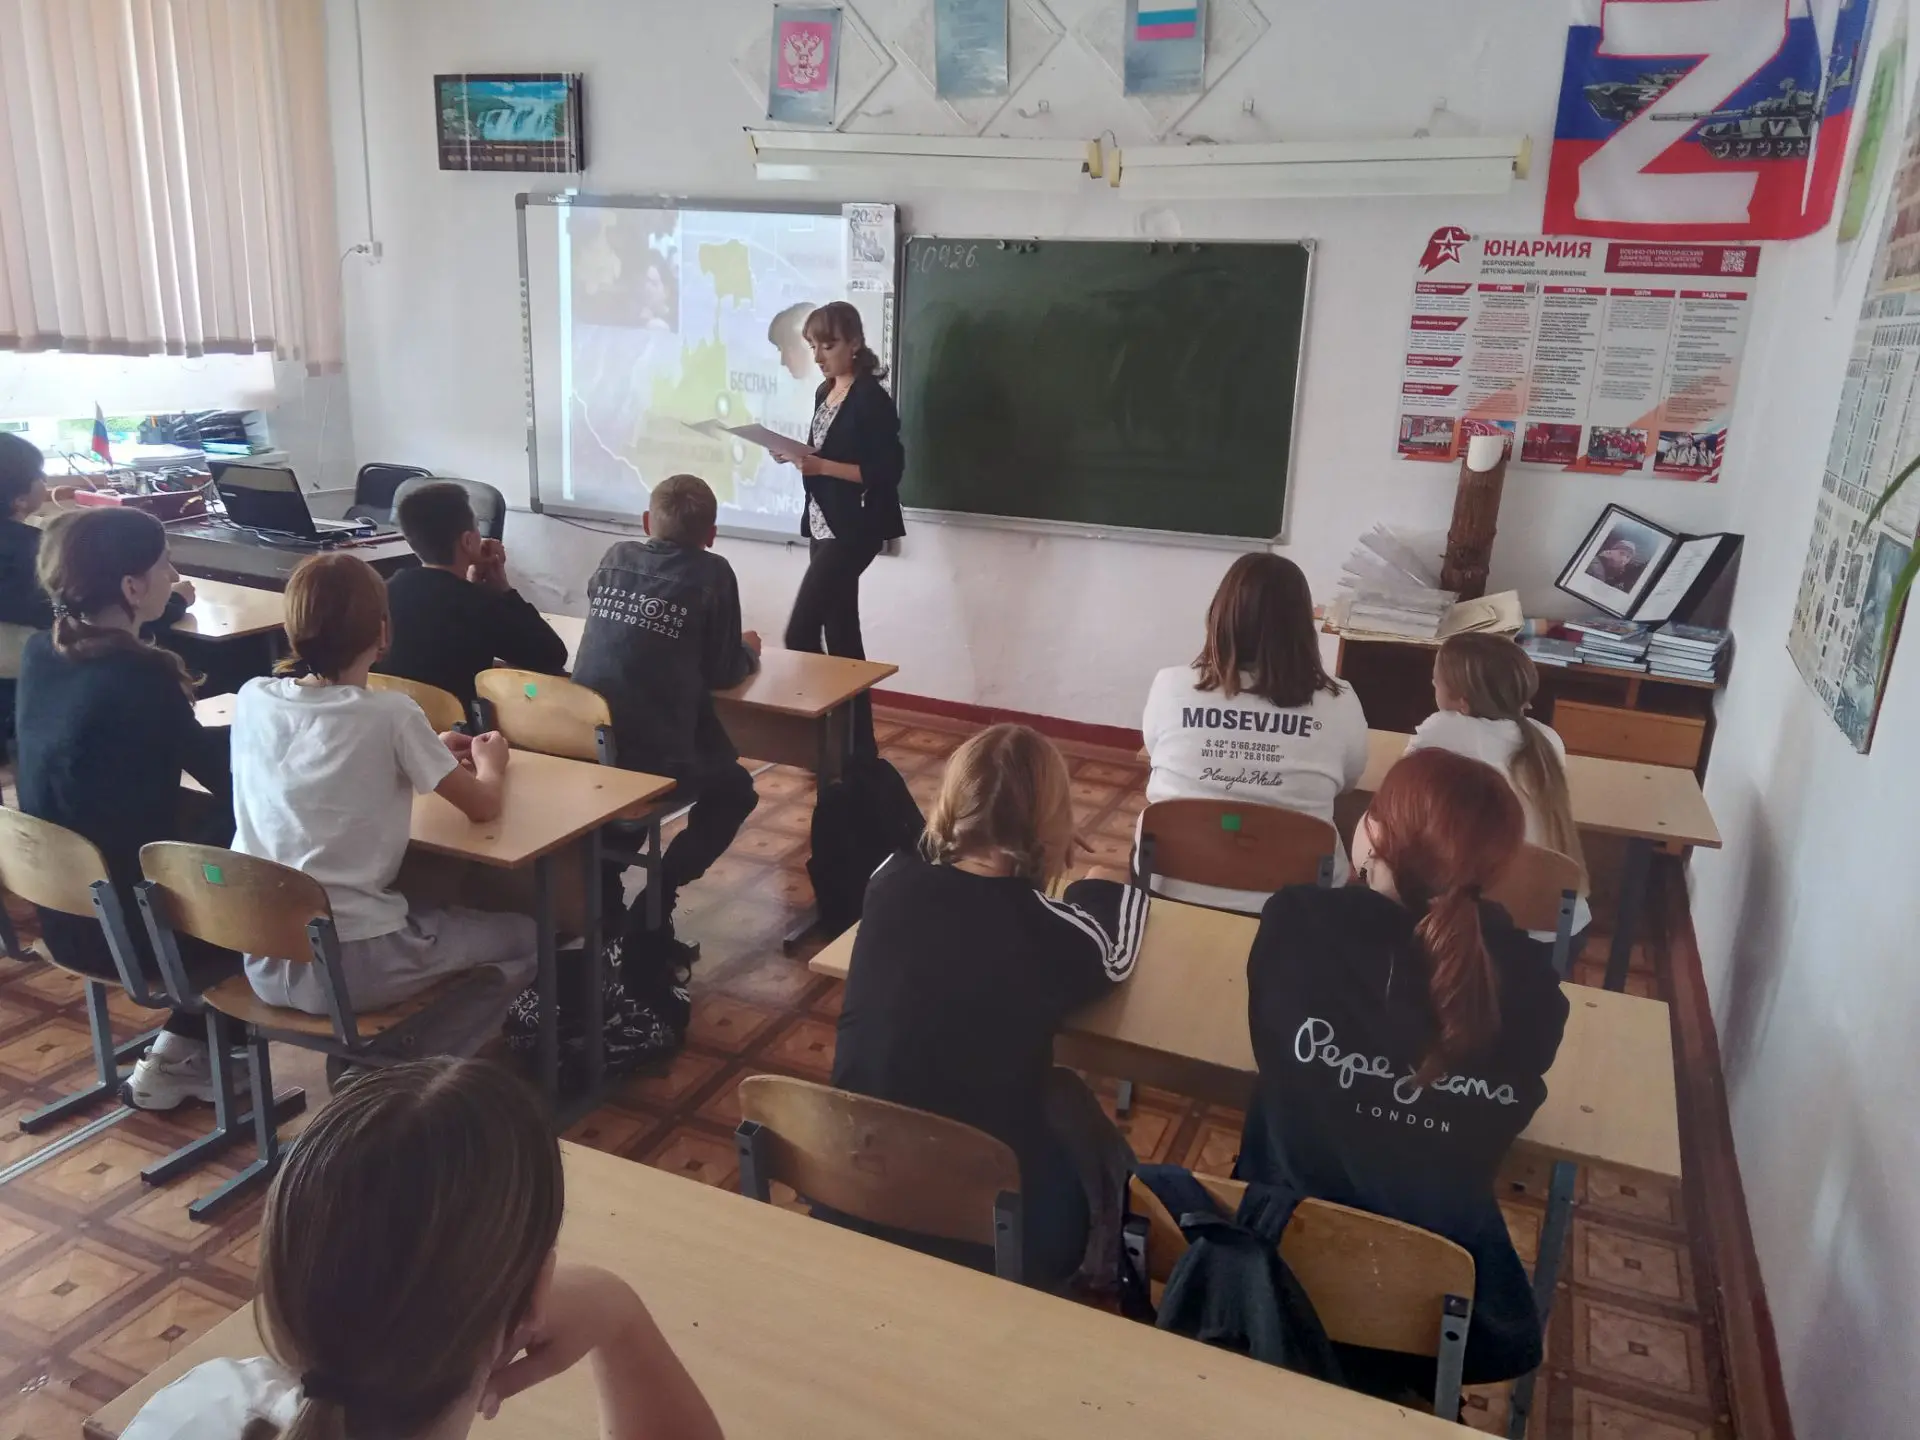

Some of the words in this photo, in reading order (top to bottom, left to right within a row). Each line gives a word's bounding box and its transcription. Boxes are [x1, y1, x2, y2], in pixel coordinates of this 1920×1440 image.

[1483, 239, 1592, 258] ЮНАРМИЯ
[730, 370, 778, 394] БЕСЛАН
[602, 598, 612, 607] 11
[614, 600, 625, 609] 12
[628, 603, 639, 613] 13
[619, 589, 626, 597] 3
[629, 592, 636, 600] 4
[670, 604, 677, 612] 8
[680, 607, 688, 616] 9
[598, 608, 609, 618] 18
[610, 610, 621, 621] 19
[624, 614, 637, 625] 20
[638, 618, 651, 629] 21
[652, 622, 666, 634] 22
[666, 627, 680, 639] 23
[1206, 739, 1212, 748] S
[1294, 1017, 1395, 1089] Pepe
[1355, 1102, 1451, 1133] LONDON
